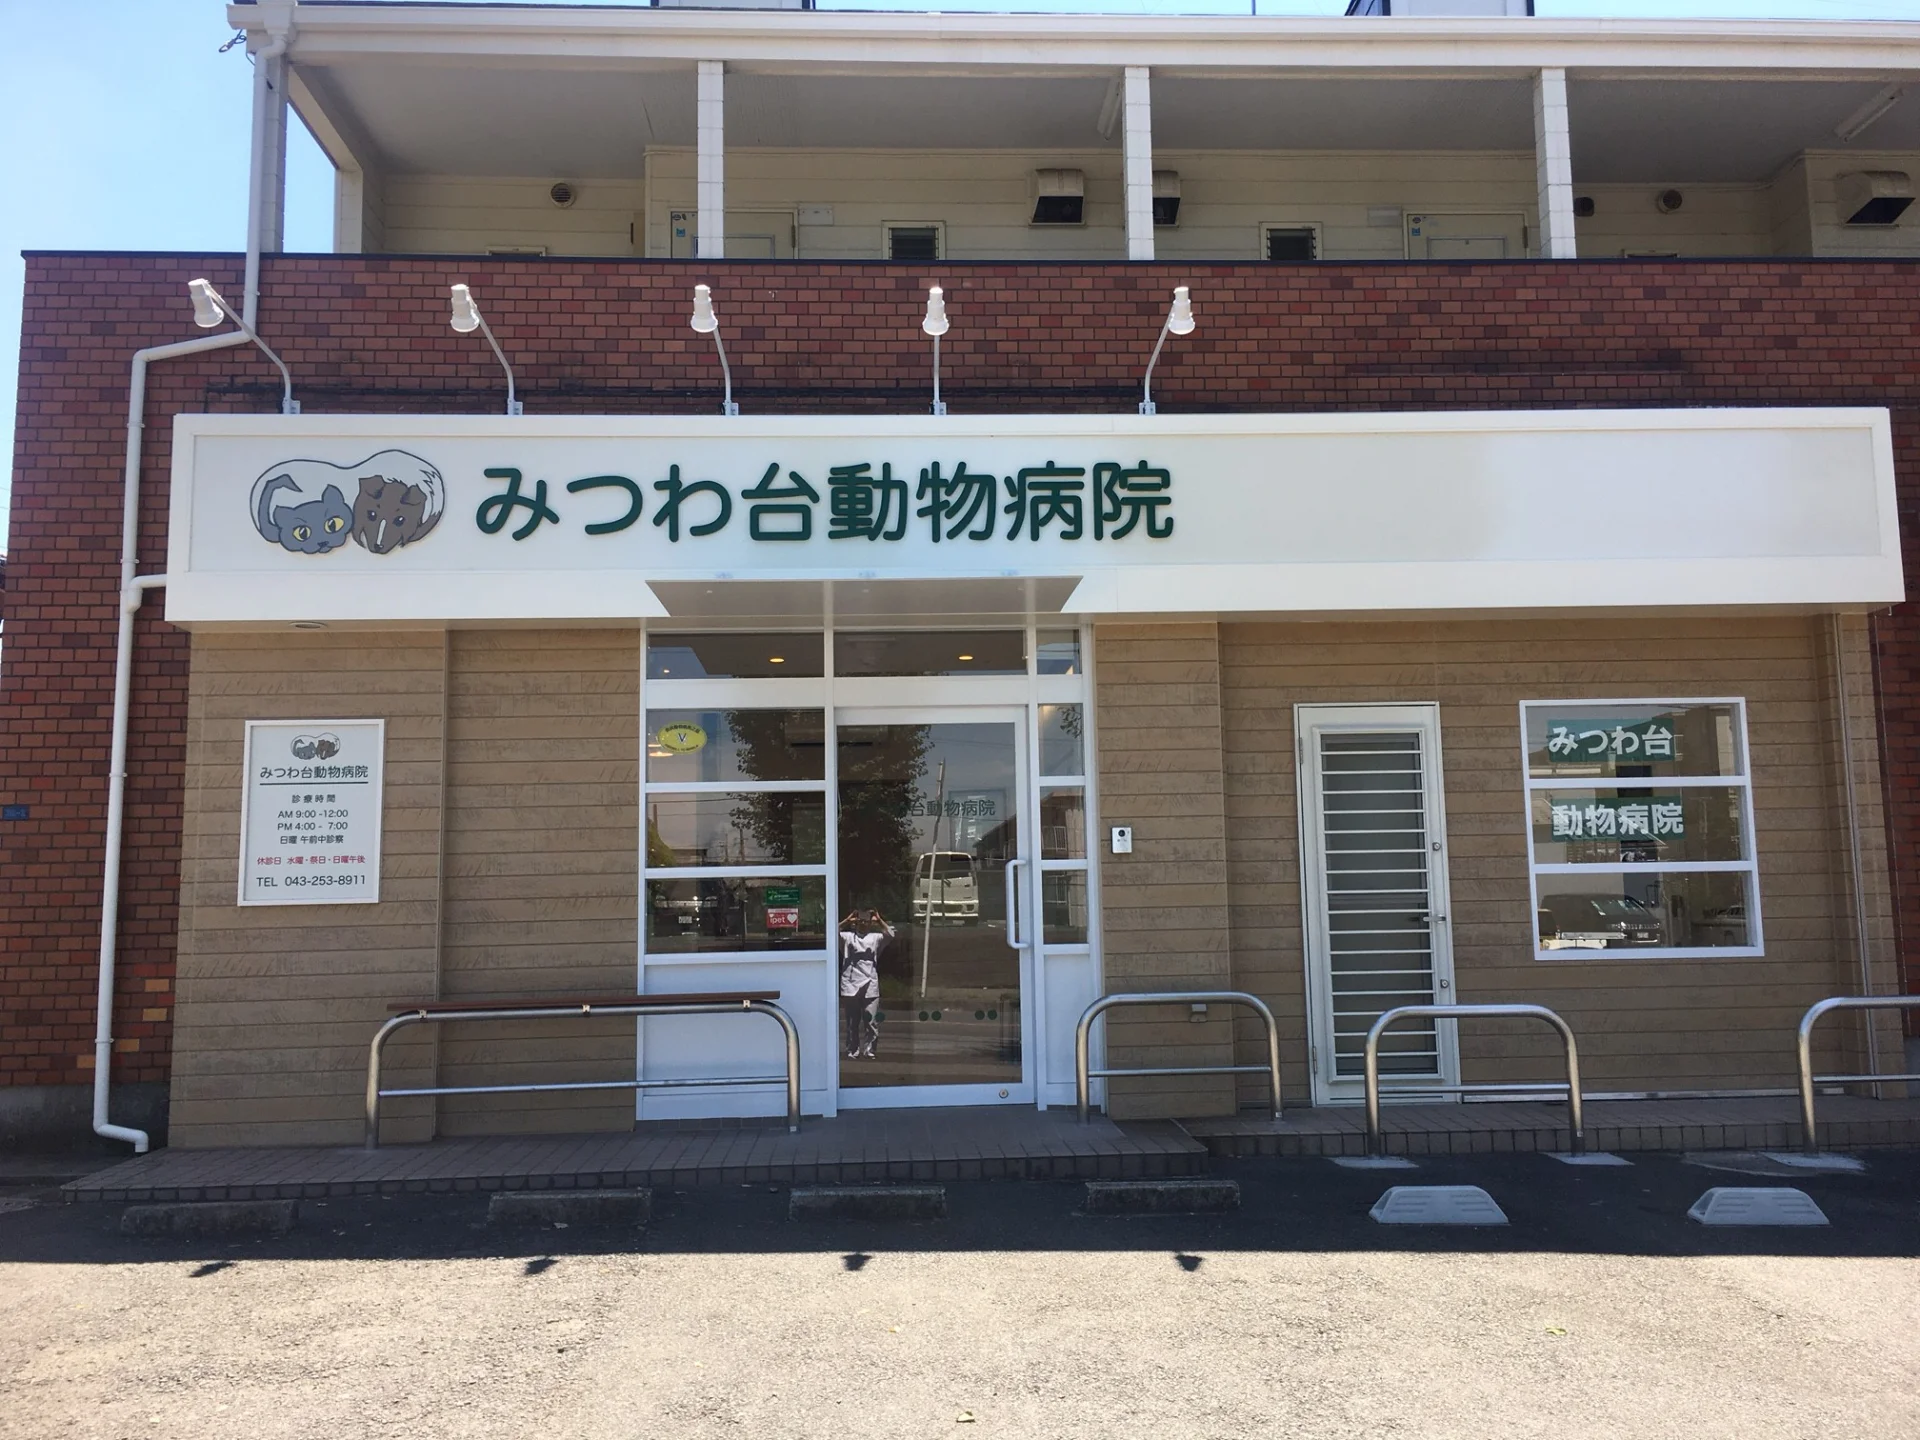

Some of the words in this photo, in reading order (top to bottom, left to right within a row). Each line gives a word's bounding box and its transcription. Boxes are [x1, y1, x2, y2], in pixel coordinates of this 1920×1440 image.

[475, 460, 1174, 544] みつわ台動物病院
[1549, 725, 1673, 756] みつわ台
[260, 766, 368, 778] みつわ台動物病院
[292, 795, 335, 803] 診療時間
[278, 810, 293, 818] AM
[1551, 803, 1684, 837] 動物病院
[277, 822, 293, 831] PM
[294, 822, 316, 831] 4:00
[327, 821, 348, 830] 7:00
[280, 835, 298, 845] 日曜
[300, 835, 344, 844] 午前中診察
[257, 857, 281, 865] 休診日
[256, 877, 278, 886] TEL
[285, 875, 365, 886] 043-253-8911
